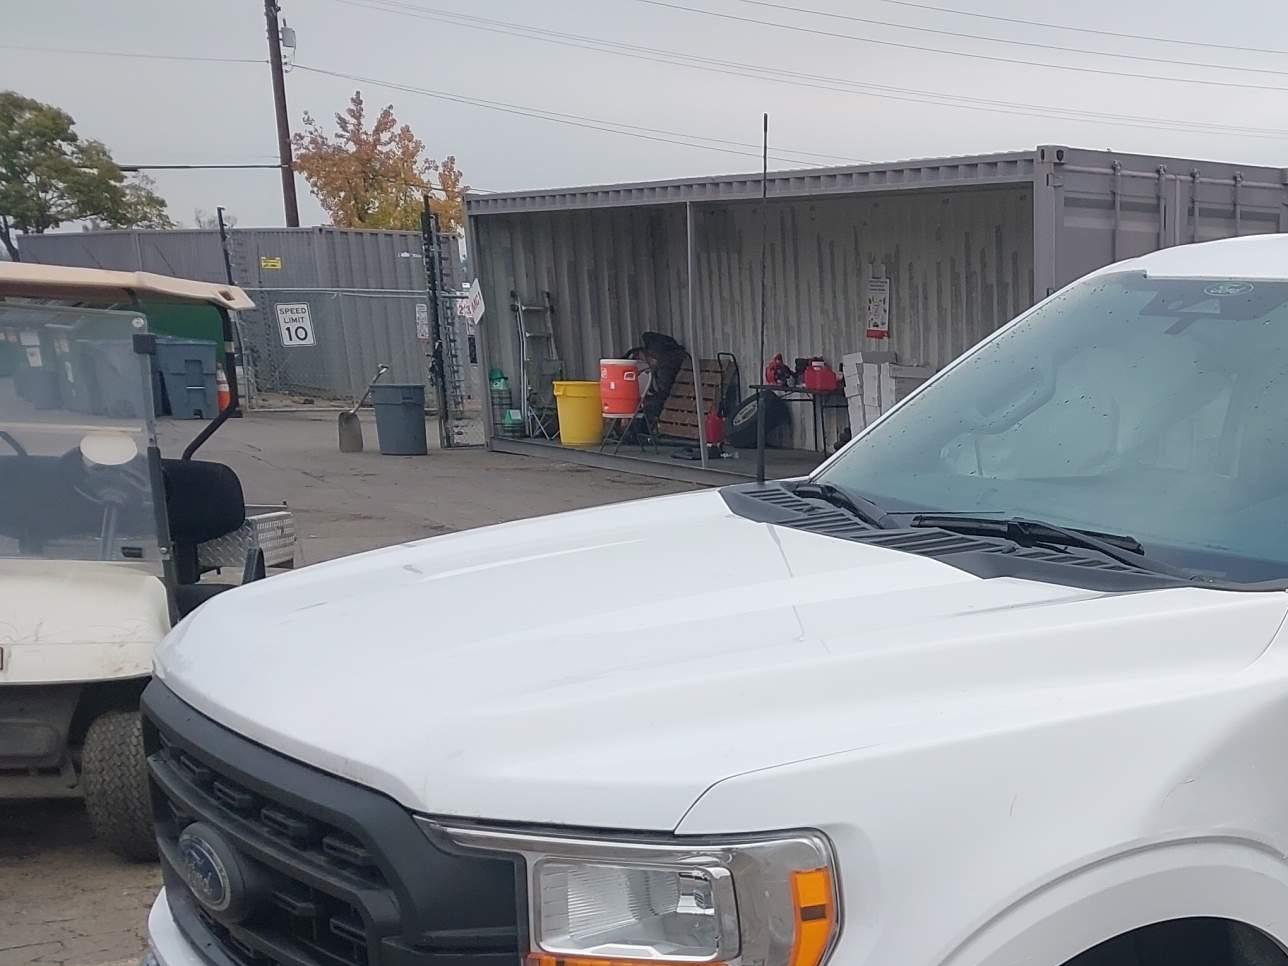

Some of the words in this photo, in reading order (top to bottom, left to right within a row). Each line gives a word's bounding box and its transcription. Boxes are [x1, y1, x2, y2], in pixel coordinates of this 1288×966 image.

[279, 307, 307, 315] SPEED
[283, 316, 305, 324] LIMIT
[285, 325, 308, 342] 10
